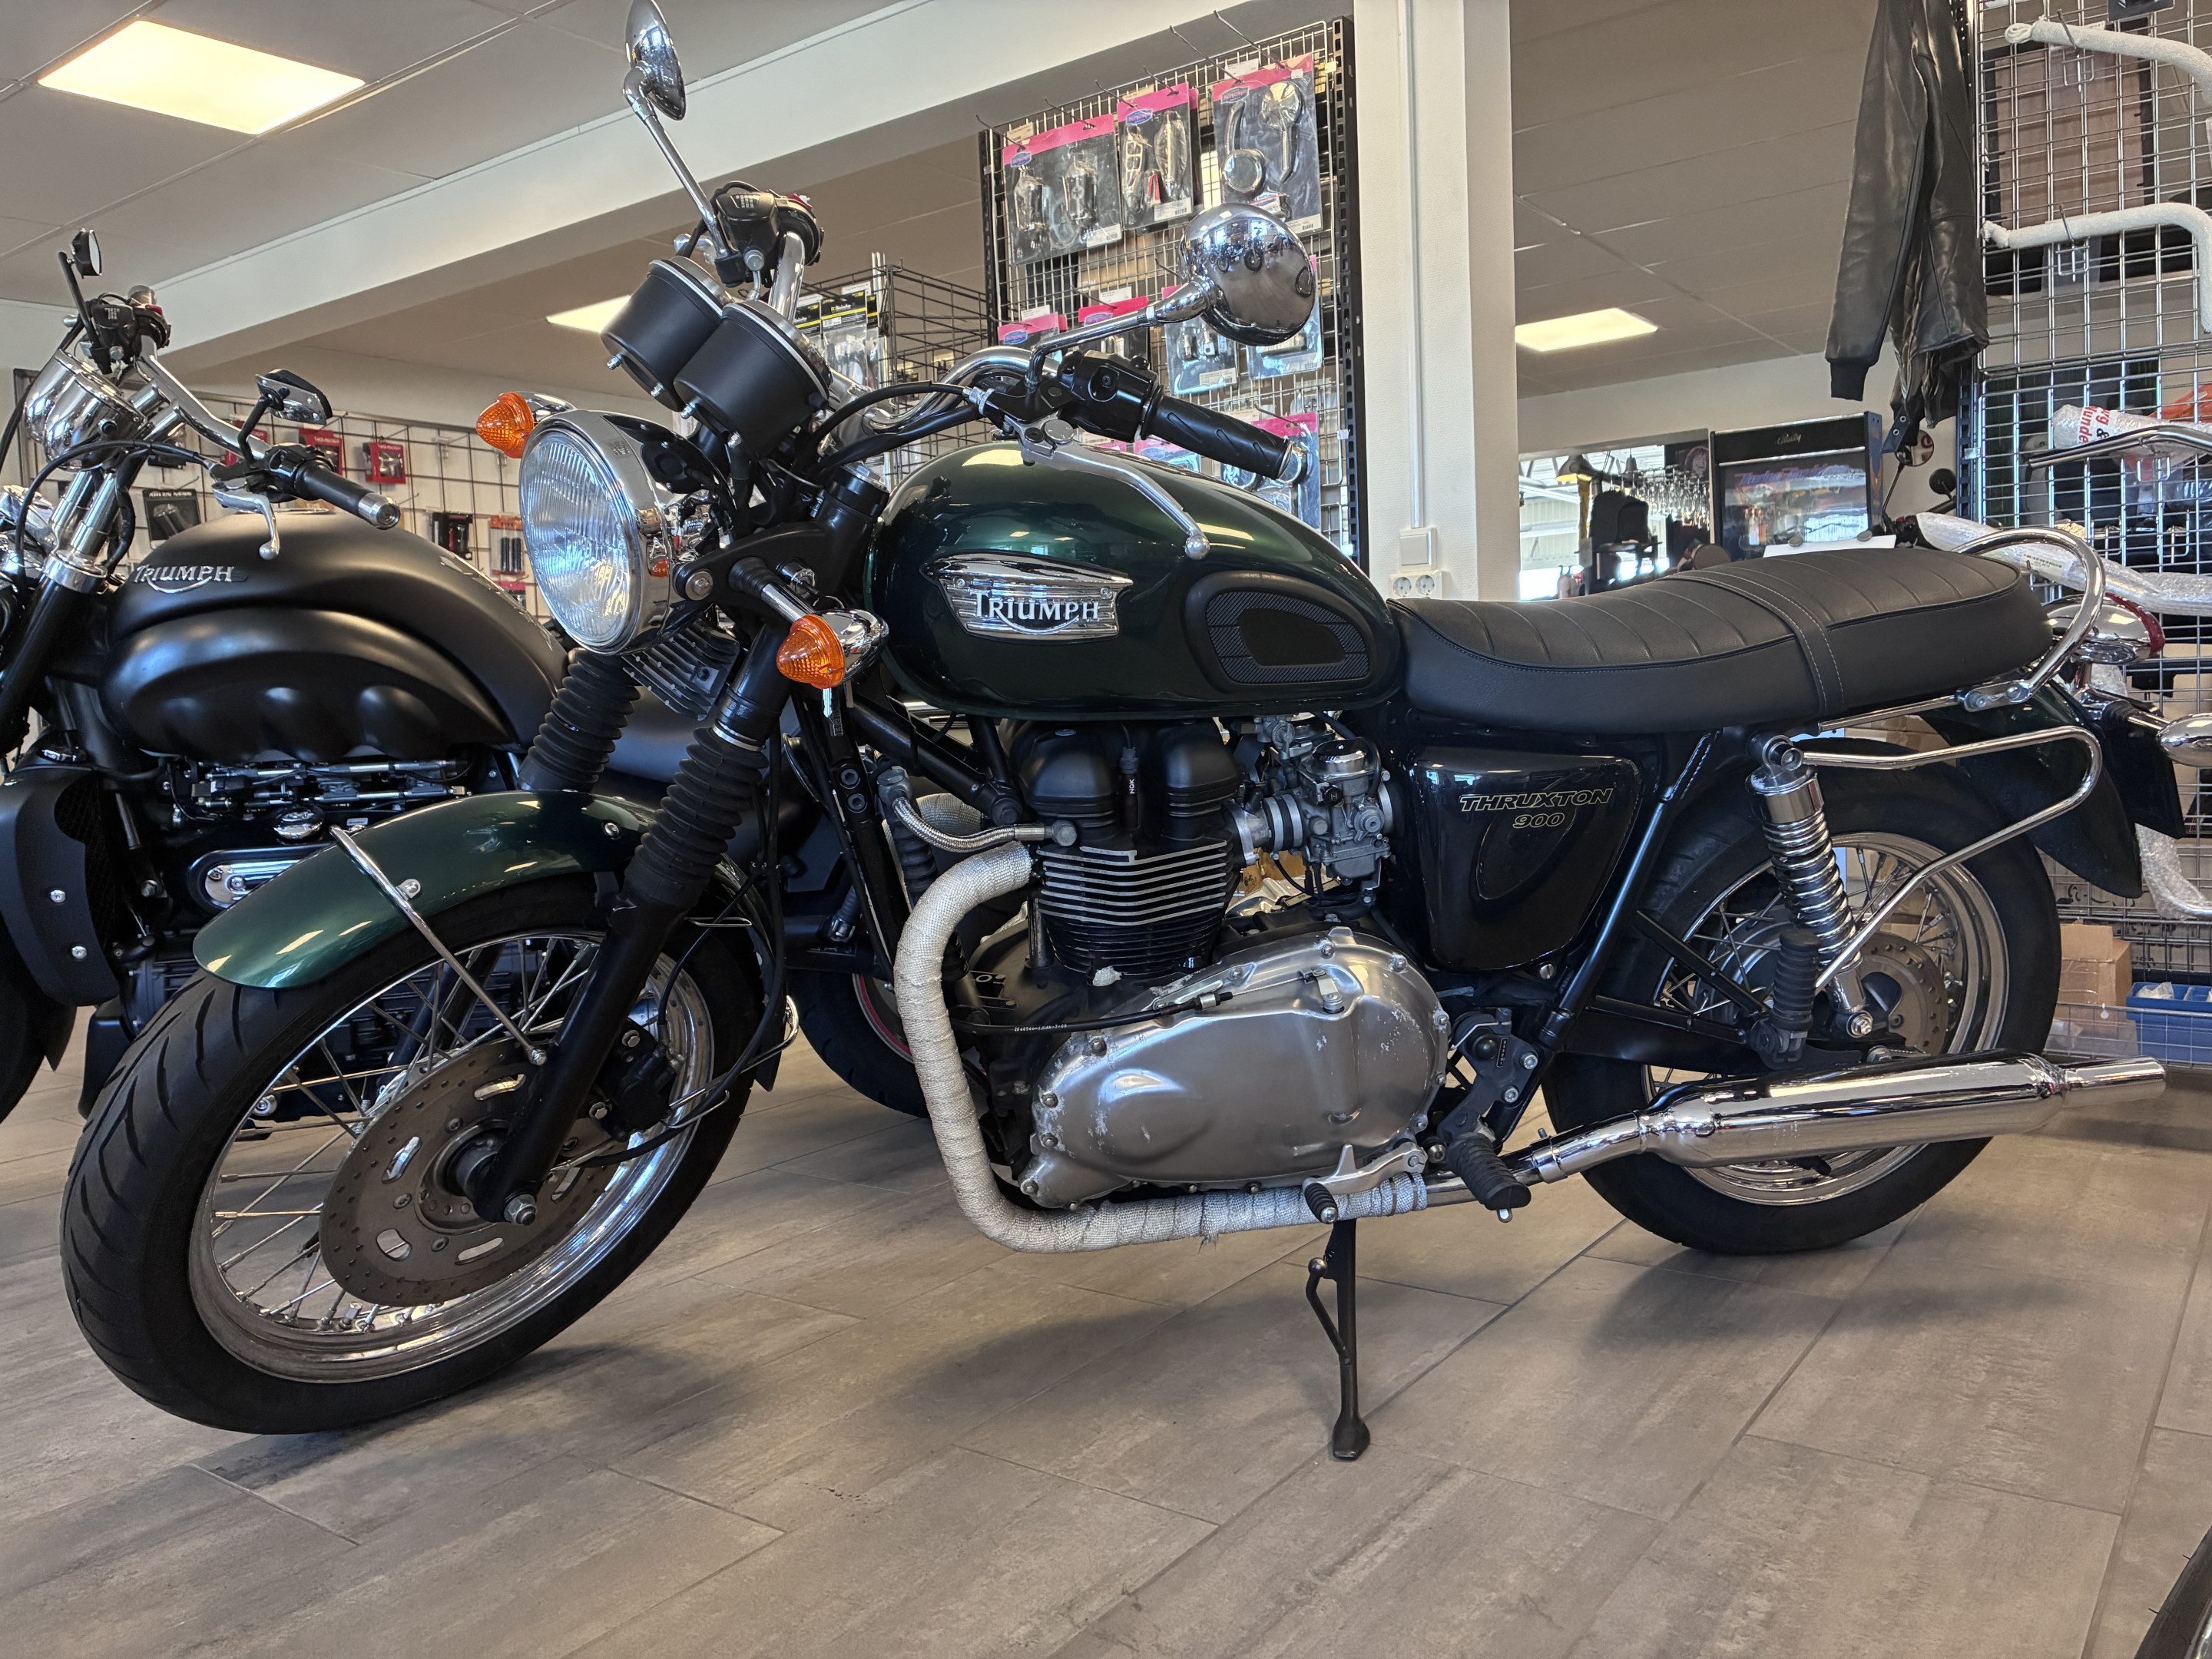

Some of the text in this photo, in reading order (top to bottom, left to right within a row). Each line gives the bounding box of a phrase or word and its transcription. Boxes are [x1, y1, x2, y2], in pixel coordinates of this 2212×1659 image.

[134, 563, 235, 590] TRIUMPH
[969, 588, 1100, 630] TRIUMPH
[1459, 788, 1614, 812] THRUXTON
[1512, 813, 1565, 829] 900
